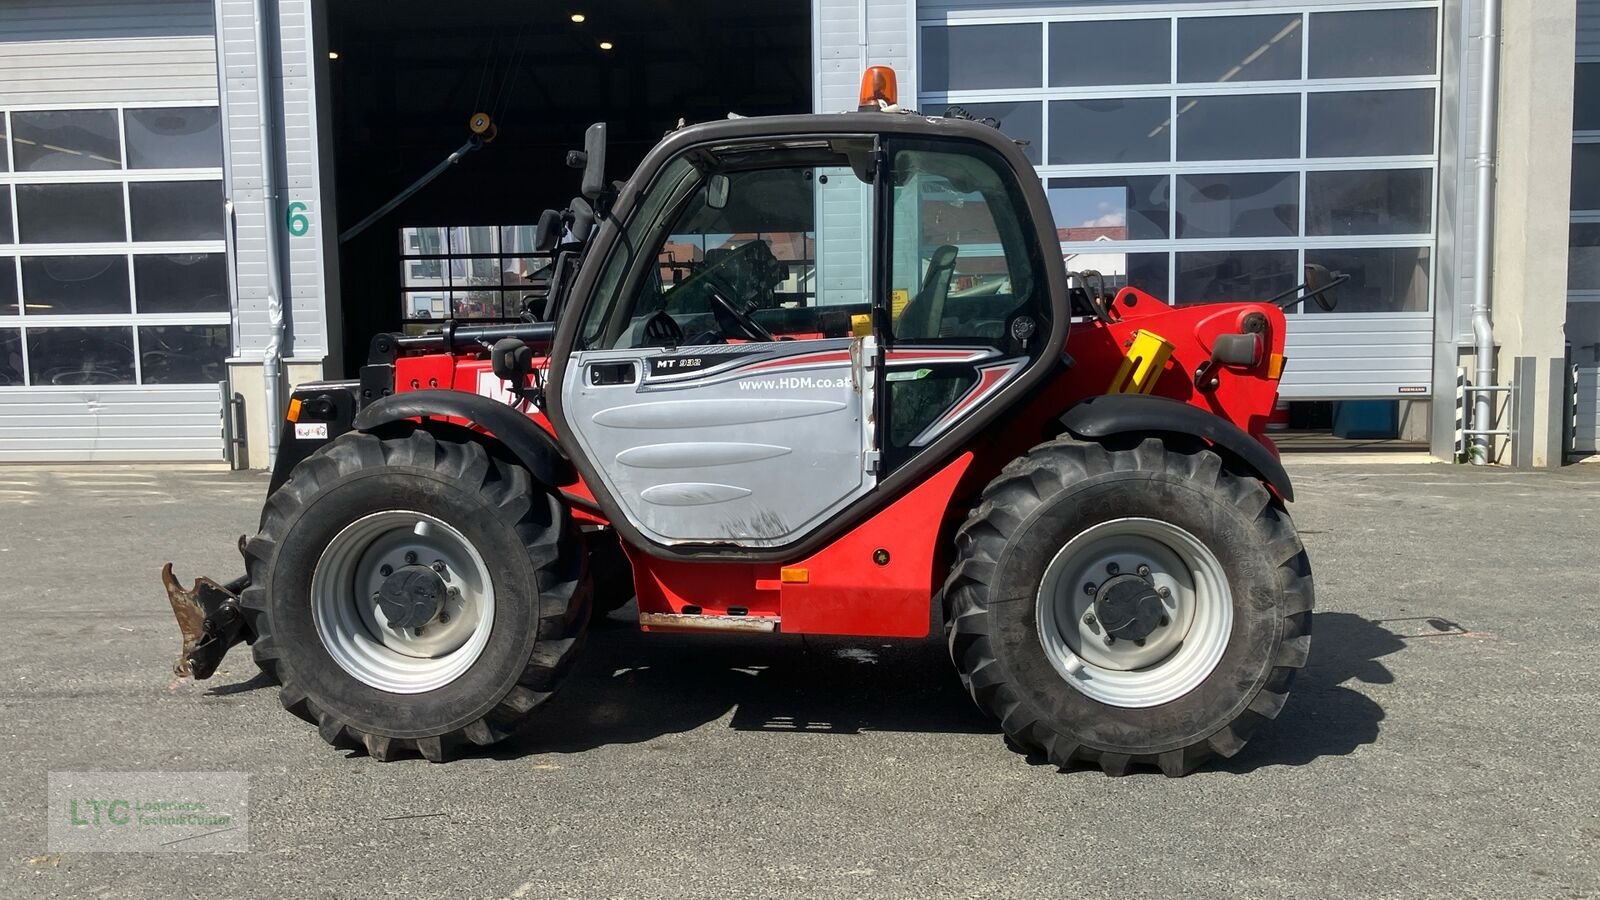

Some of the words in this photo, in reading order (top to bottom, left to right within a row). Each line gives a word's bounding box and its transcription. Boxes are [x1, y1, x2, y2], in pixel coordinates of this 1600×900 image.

[286, 201, 309, 237] 6
[656, 359, 676, 369] MT
[738, 375, 852, 391] www.HDM.co.at
